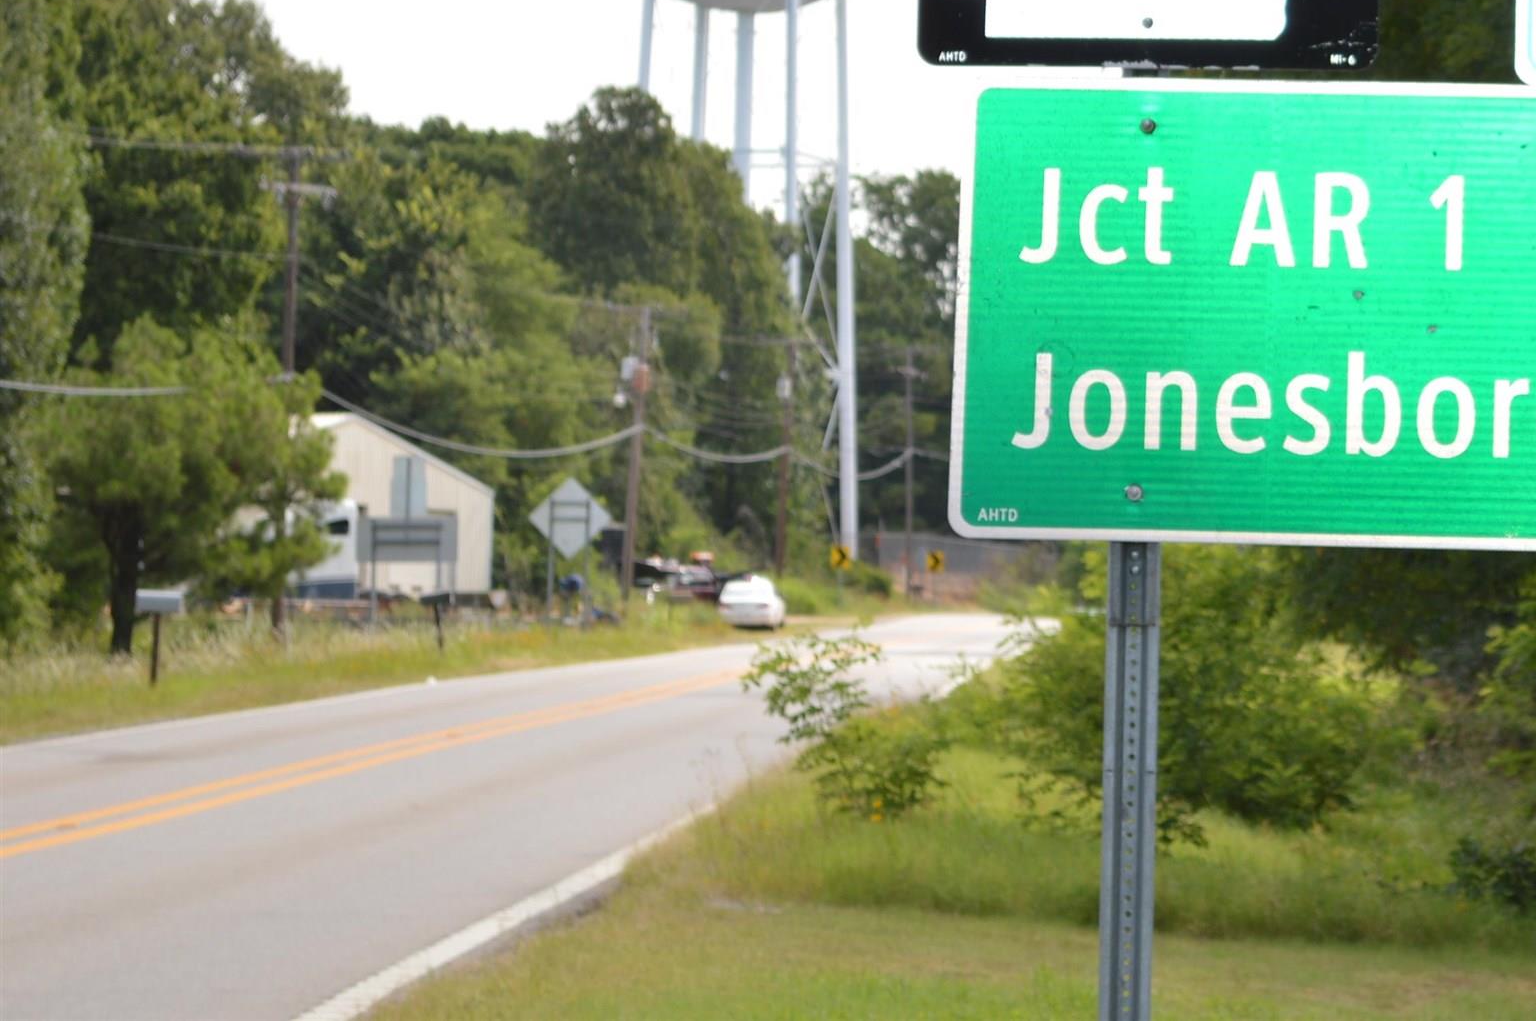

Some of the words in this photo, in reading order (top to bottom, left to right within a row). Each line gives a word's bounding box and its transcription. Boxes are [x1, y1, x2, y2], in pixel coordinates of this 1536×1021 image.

[939, 50, 967, 62] AHTD
[1019, 166, 1174, 265] Jct
[1229, 170, 1371, 270] AR
[1429, 174, 1465, 271] 1
[977, 507, 1018, 522] AHTD
